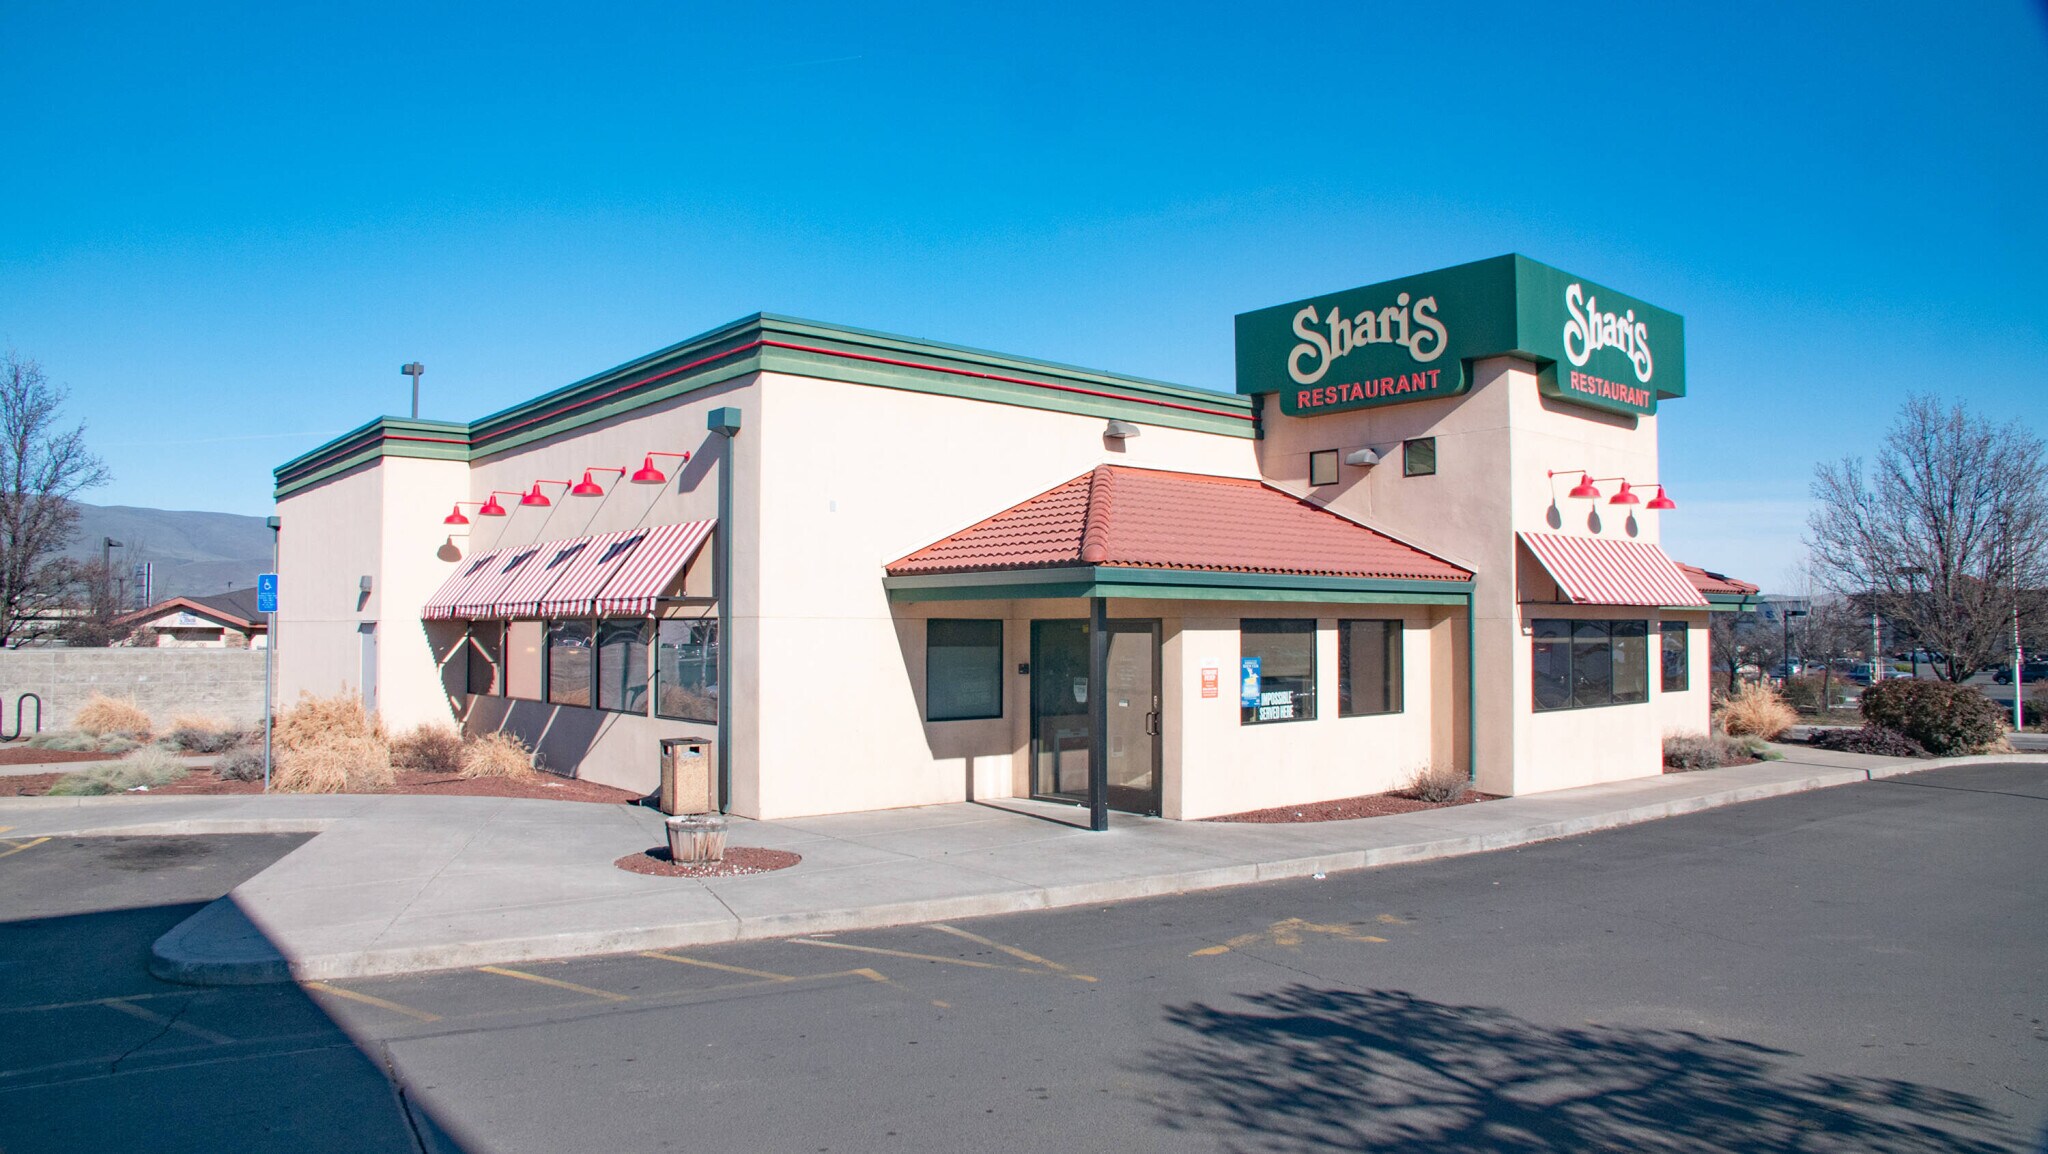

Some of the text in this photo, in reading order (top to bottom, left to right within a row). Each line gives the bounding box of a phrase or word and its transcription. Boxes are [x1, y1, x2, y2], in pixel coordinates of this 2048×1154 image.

[1297, 369, 1441, 409] RESTAURANT
[1570, 371, 1650, 408] RESTAURANT
[1261, 691, 1294, 706] IMPOSSIBLE
[1259, 704, 1294, 721] SERVED HERE
